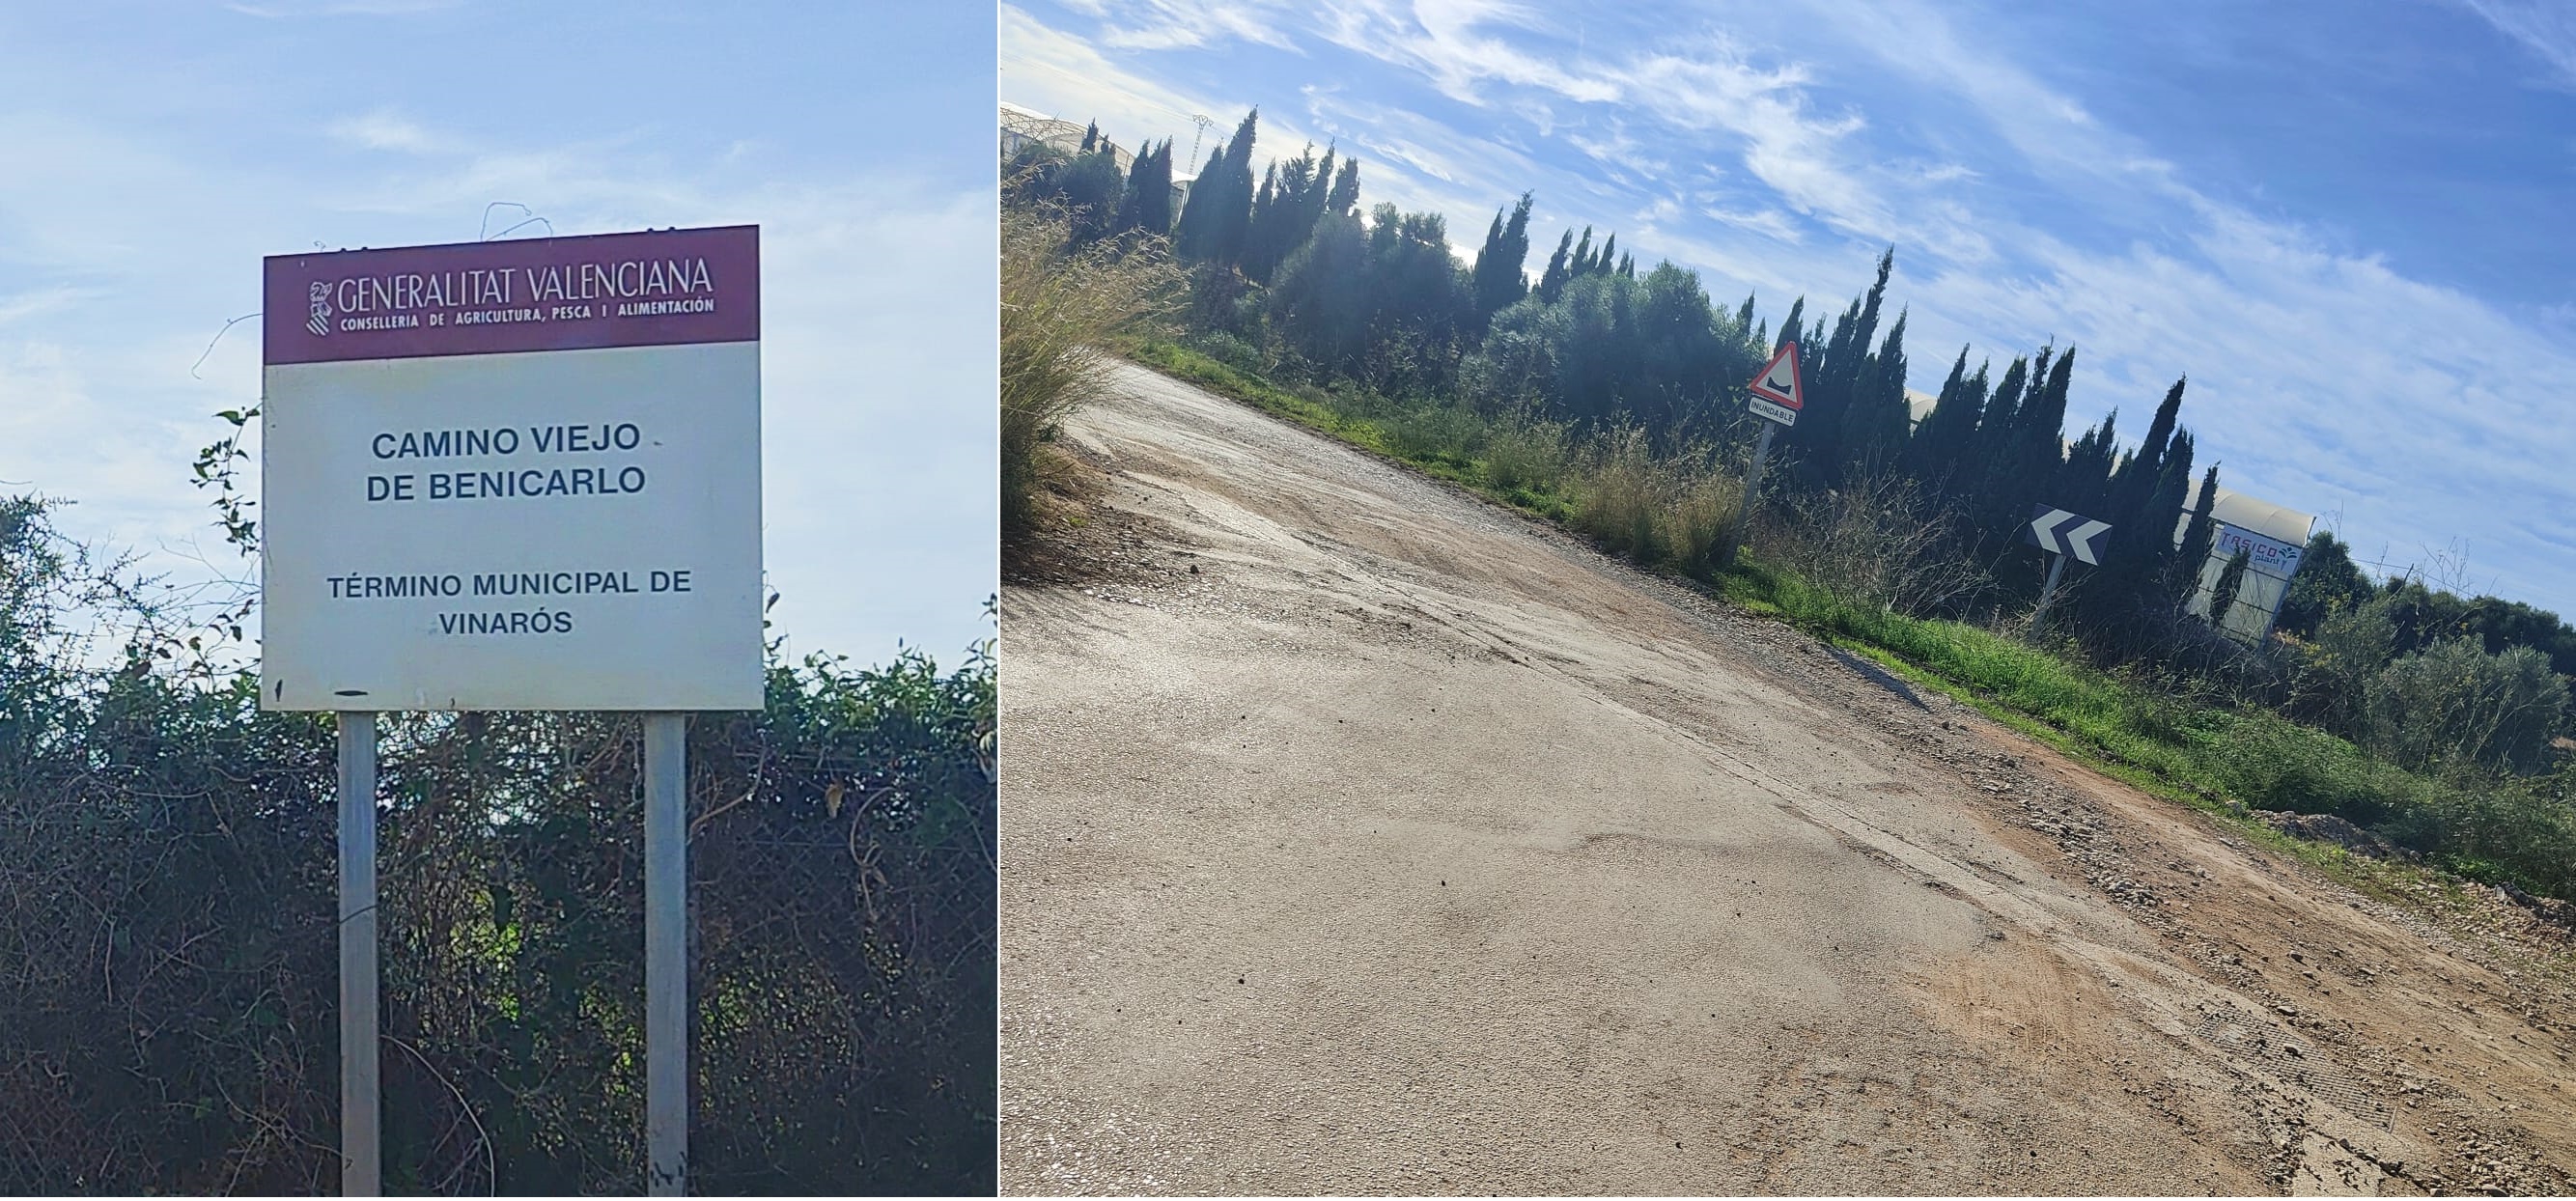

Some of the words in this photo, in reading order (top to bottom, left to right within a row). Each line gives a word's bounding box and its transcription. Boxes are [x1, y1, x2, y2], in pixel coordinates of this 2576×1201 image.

[338, 268, 515, 313] GENERALITAT
[527, 259, 713, 301] VALENCIANA
[340, 314, 419, 331] CONSELLERIA
[431, 313, 445, 326] DE
[455, 306, 546, 324] AGRICULTURA,
[551, 306, 592, 321] PESCA
[618, 295, 714, 316] ALIMENTACIÓN
[1750, 401, 1795, 423] INUNDABLE
[372, 428, 519, 460] CAMINO
[530, 424, 641, 453] VIEJO
[367, 475, 415, 501] DE
[430, 466, 646, 499] BENICARLO
[326, 572, 462, 599] TÉRMINO
[473, 573, 639, 596] MUNICIPAL
[651, 571, 692, 593] DE
[439, 606, 574, 634] VINARÓS
